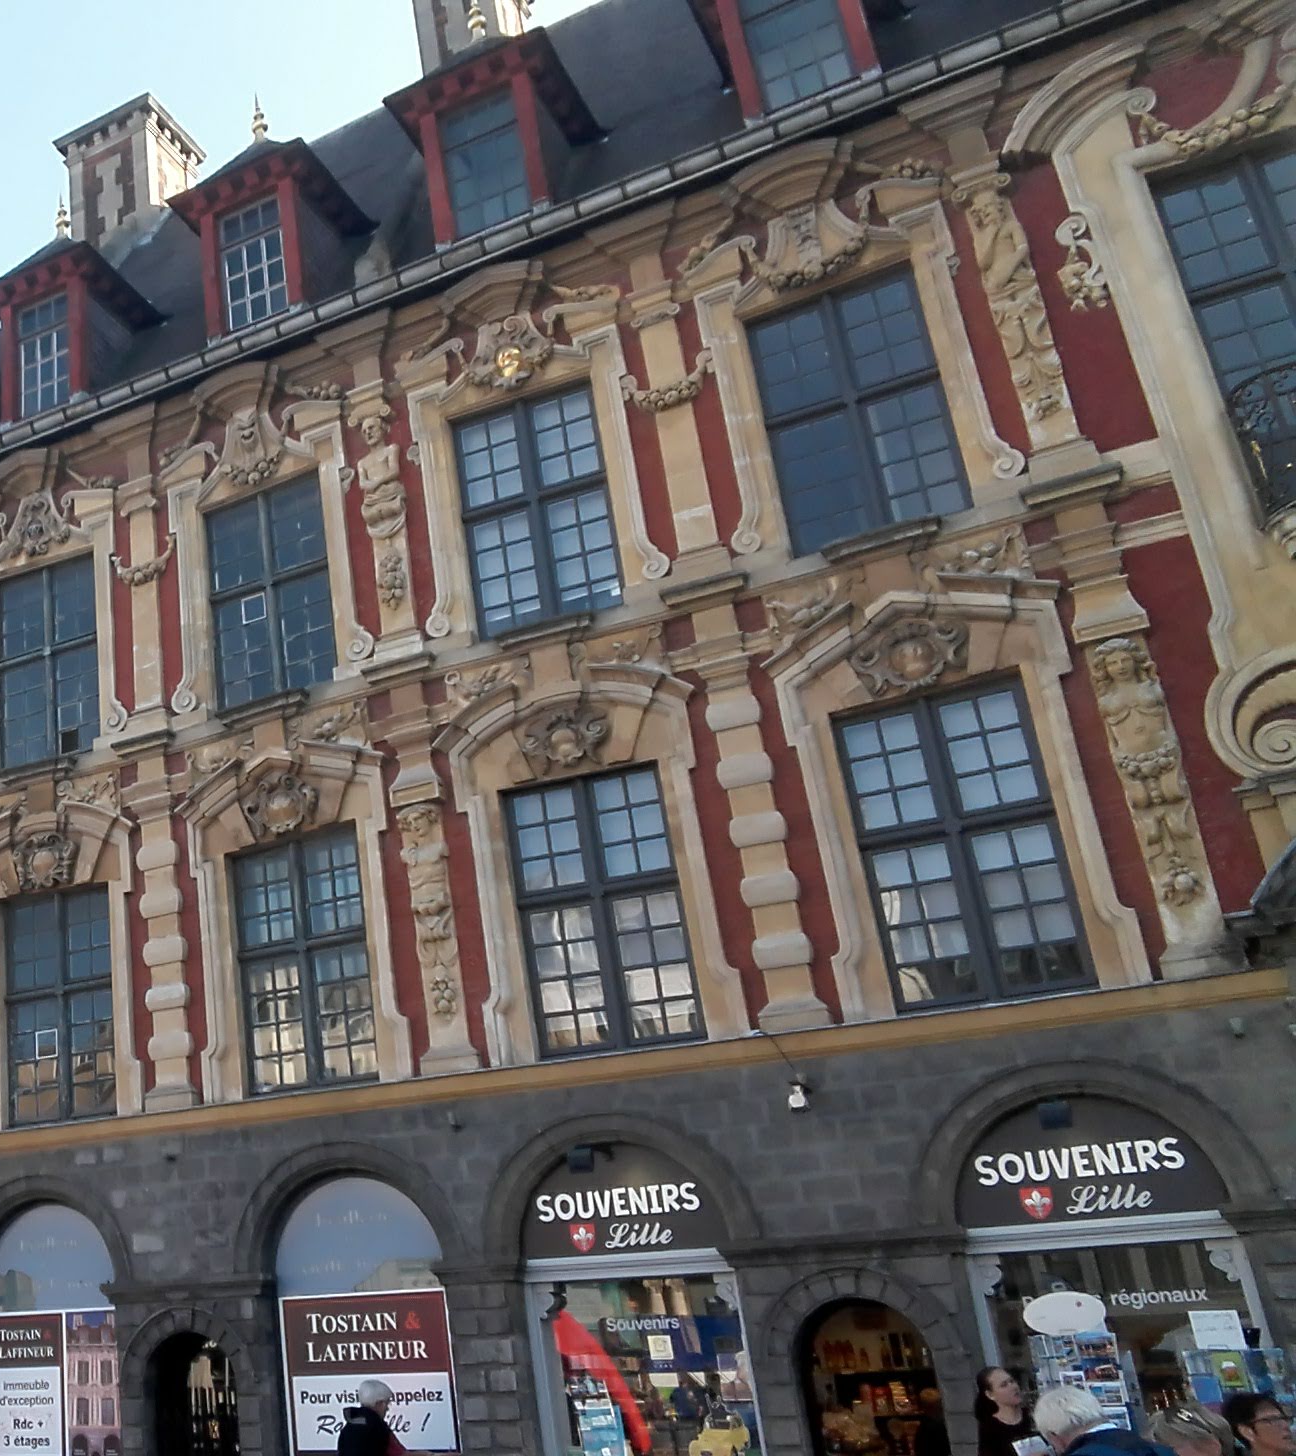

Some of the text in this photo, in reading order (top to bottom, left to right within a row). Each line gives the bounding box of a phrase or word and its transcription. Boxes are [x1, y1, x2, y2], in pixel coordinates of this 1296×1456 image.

[974, 1137, 1186, 1186] SOUVENIRS
[536, 1182, 701, 1222] SOUVENIRS
[1066, 1183, 1153, 1215] Lille
[605, 1222, 673, 1249] Lille
[1111, 1287, 1208, 1310] régionaux
[306, 1311, 421, 1334] TOSTAIN &
[606, 1316, 680, 1332] Souvenirs
[0, 1328, 41, 1341] TOSTAIN
[306, 1340, 428, 1362] LAFFINEUR
[0, 1396, 54, 1408] d'exception
[300, 1391, 332, 1405] Pour
[13, 1418, 34, 1430] Rdc
[3, 1435, 51, 1449] 3 étages
